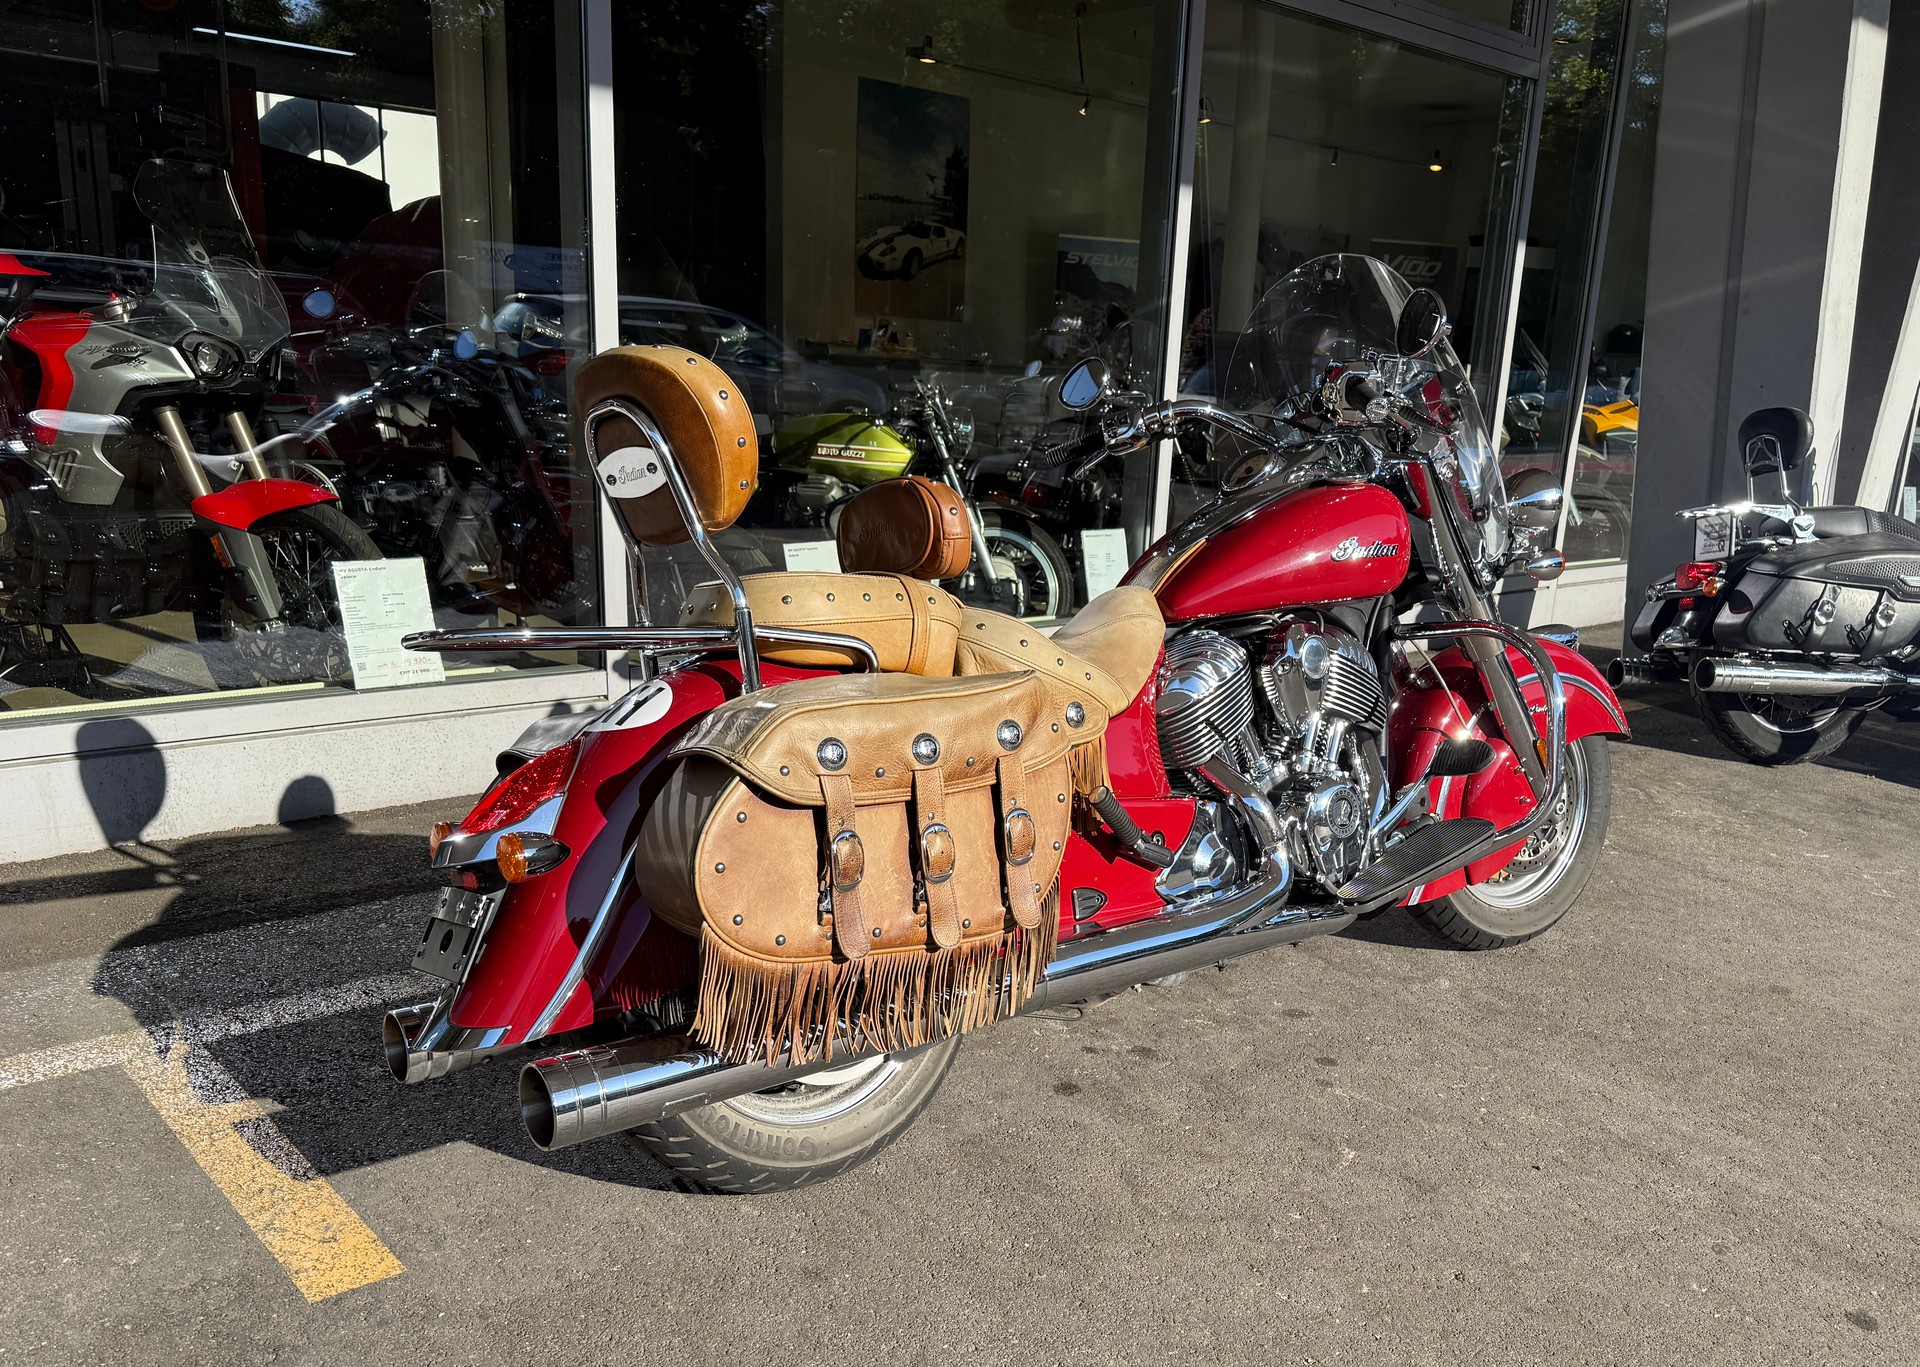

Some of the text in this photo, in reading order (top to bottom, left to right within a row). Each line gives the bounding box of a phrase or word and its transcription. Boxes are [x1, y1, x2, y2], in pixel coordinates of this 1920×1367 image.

[817, 447, 866, 459] MOTO GUZZI
[618, 465, 648, 485] Indian
[1330, 536, 1399, 562] Indian
